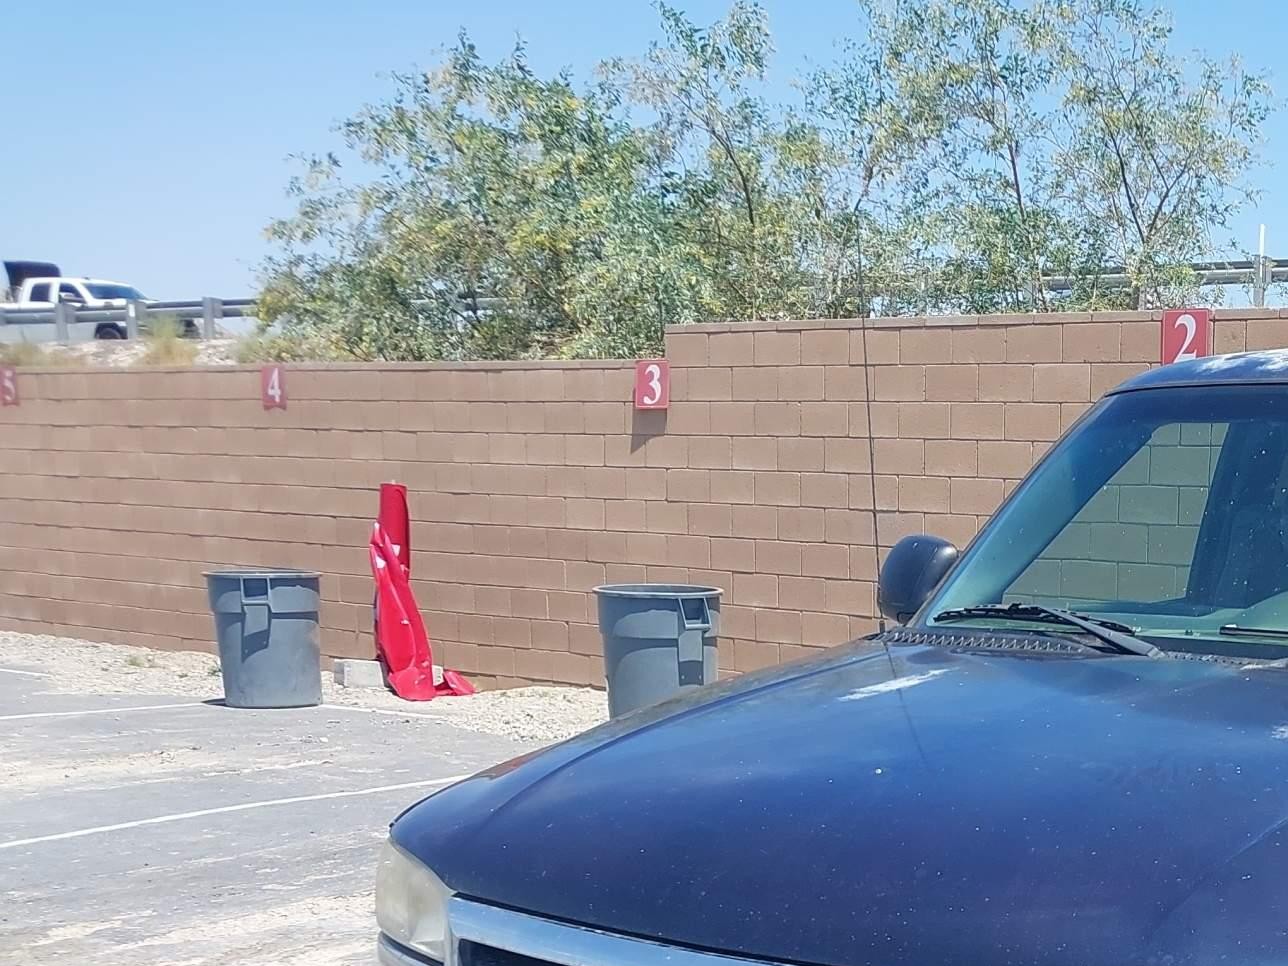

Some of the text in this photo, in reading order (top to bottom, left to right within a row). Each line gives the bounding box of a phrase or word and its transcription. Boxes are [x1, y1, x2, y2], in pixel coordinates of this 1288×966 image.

[1173, 314, 1197, 364] 2
[3, 370, 16, 401] 5
[268, 368, 281, 402] 4
[643, 364, 661, 404] 3
